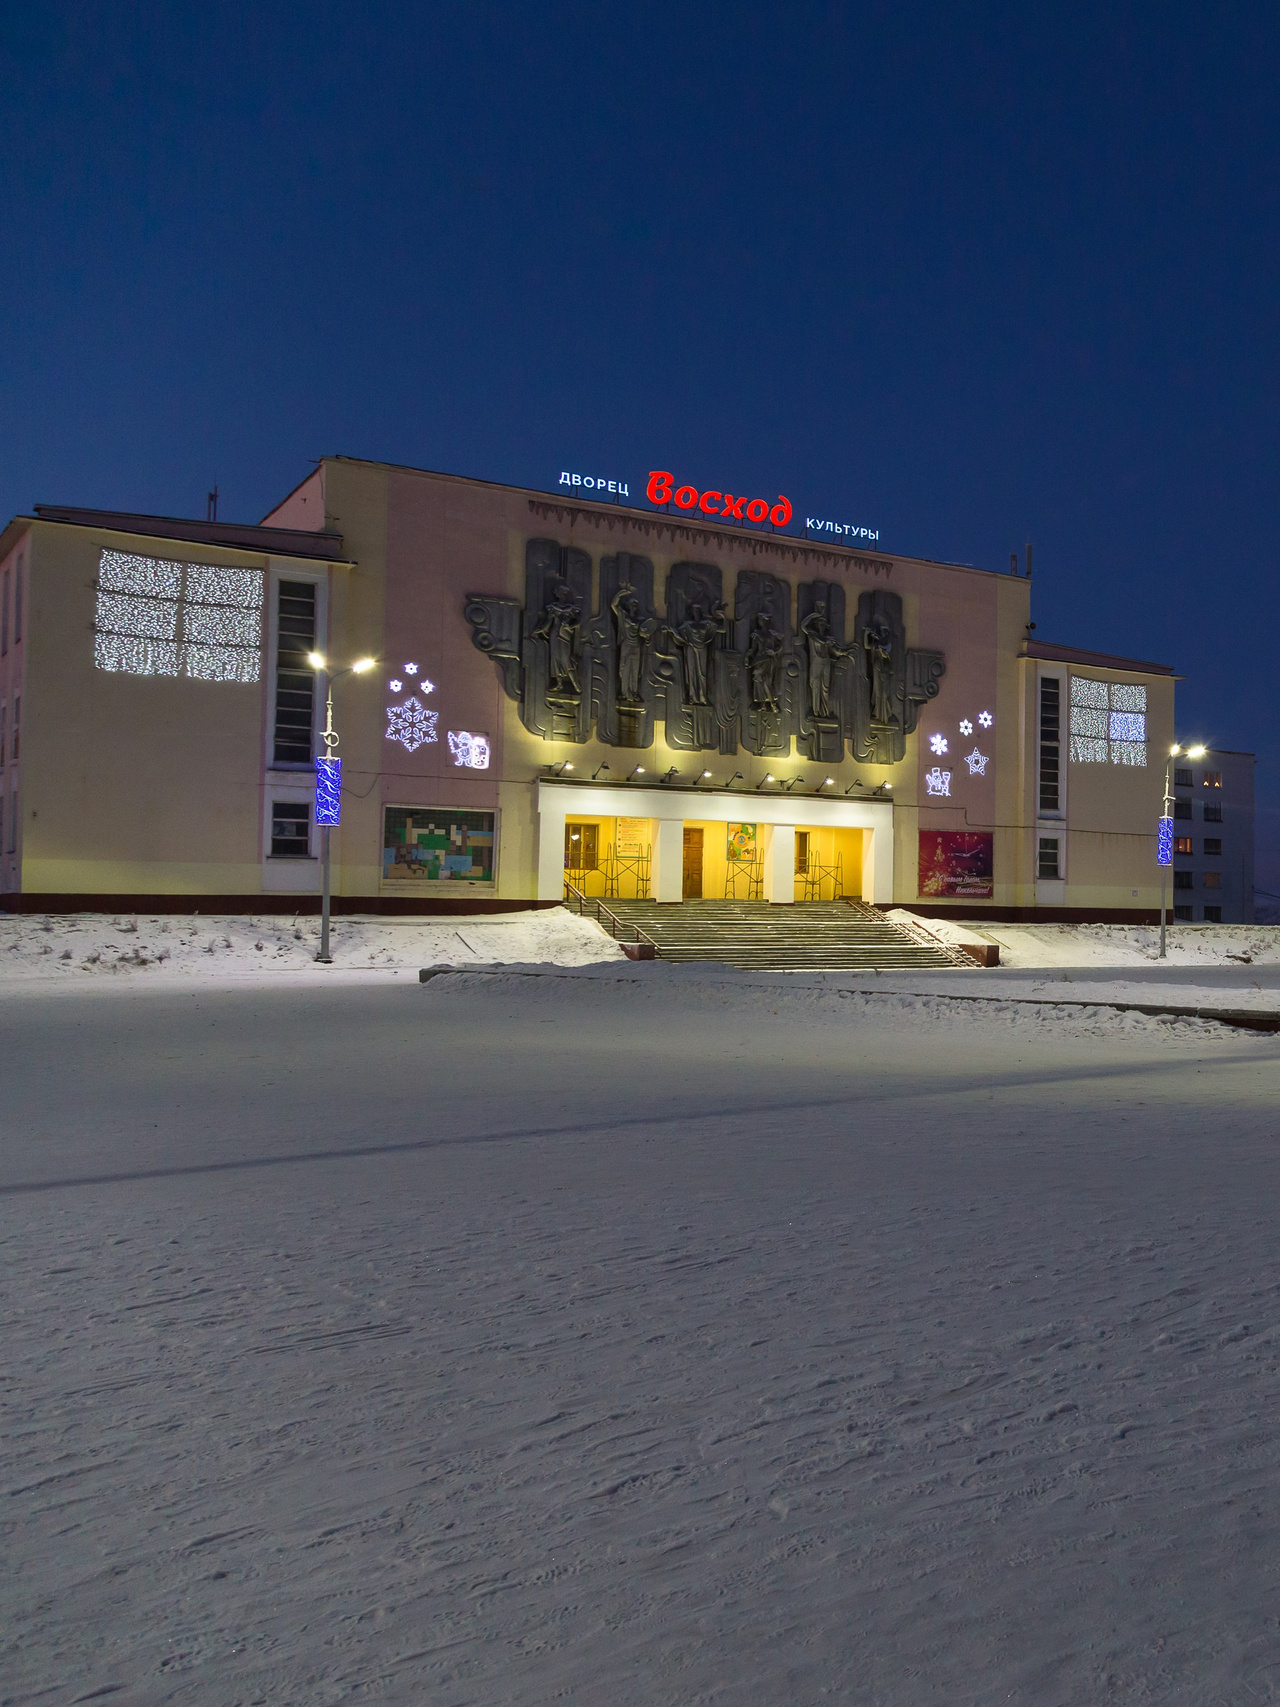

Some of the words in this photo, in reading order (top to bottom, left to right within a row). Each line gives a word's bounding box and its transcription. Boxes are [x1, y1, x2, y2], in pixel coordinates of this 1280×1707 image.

[558, 471, 629, 496] ДВОРЕЦ
[646, 471, 792, 527] Восход
[805, 517, 879, 541] КУЛЬТУРЫ
